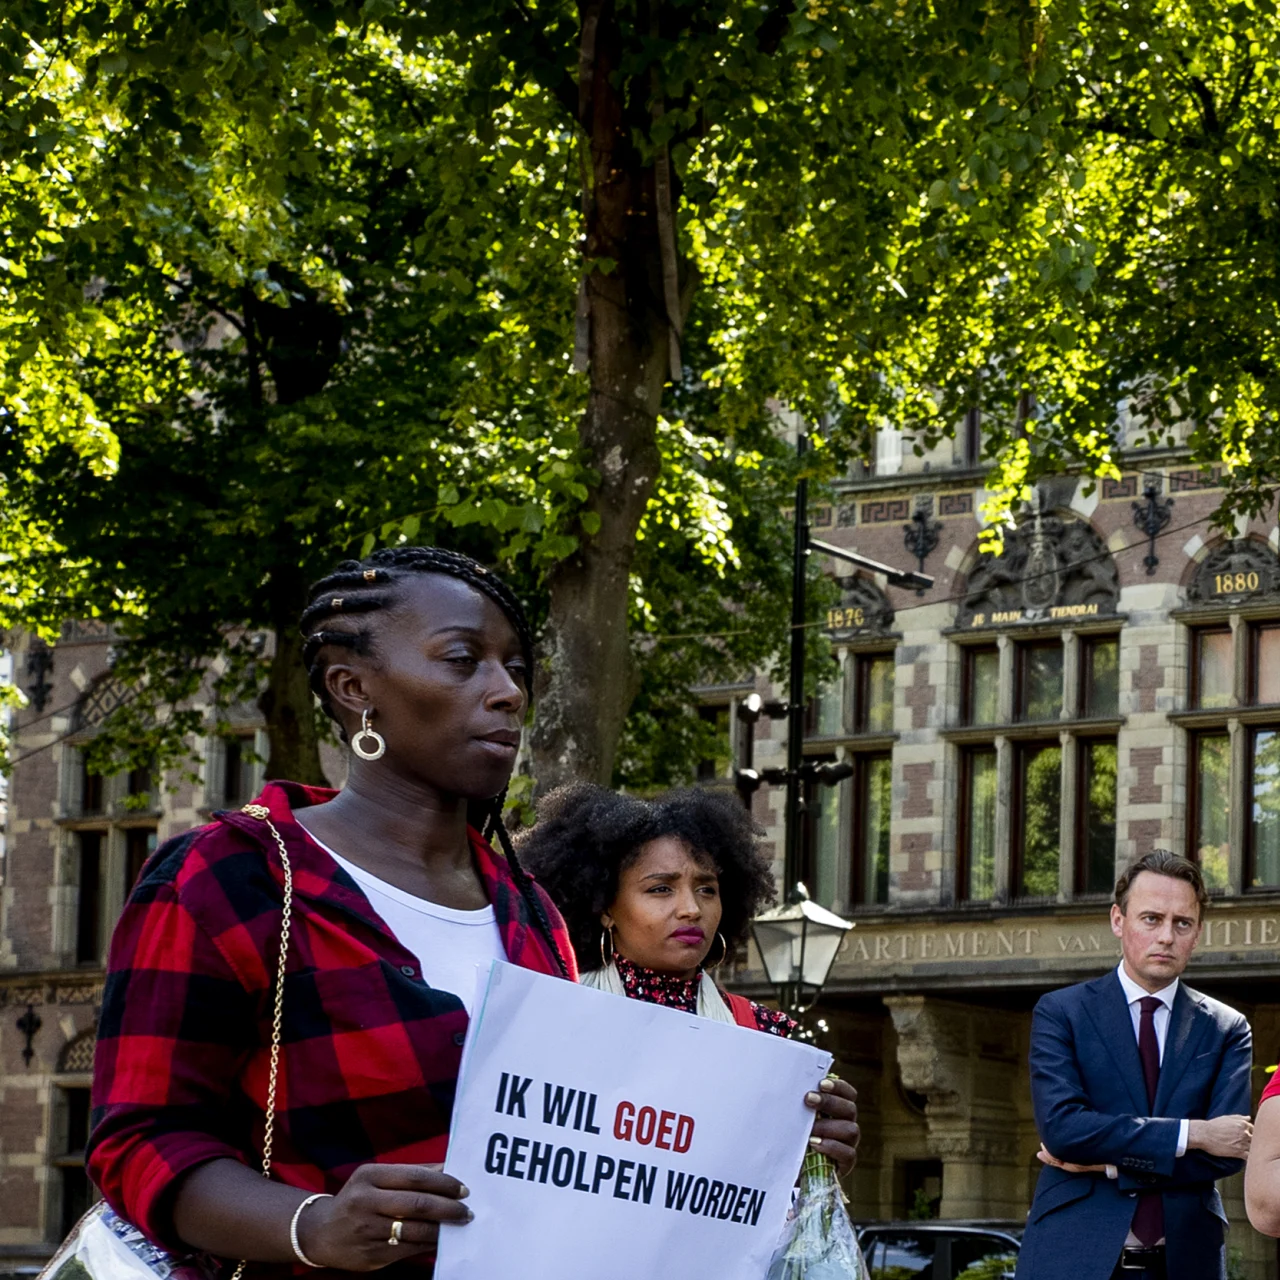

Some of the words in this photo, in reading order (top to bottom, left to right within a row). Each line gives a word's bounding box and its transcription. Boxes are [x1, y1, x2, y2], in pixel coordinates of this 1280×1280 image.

[1215, 571, 1259, 594] 1880
[835, 928, 1041, 962] PARTEMENT
[494, 1072, 533, 1119] IK
[543, 1082, 601, 1135] WIL
[613, 1101, 695, 1154] GOED
[484, 1132, 658, 1205] GEHOLPEN
[665, 1169, 767, 1227] WORDEN
